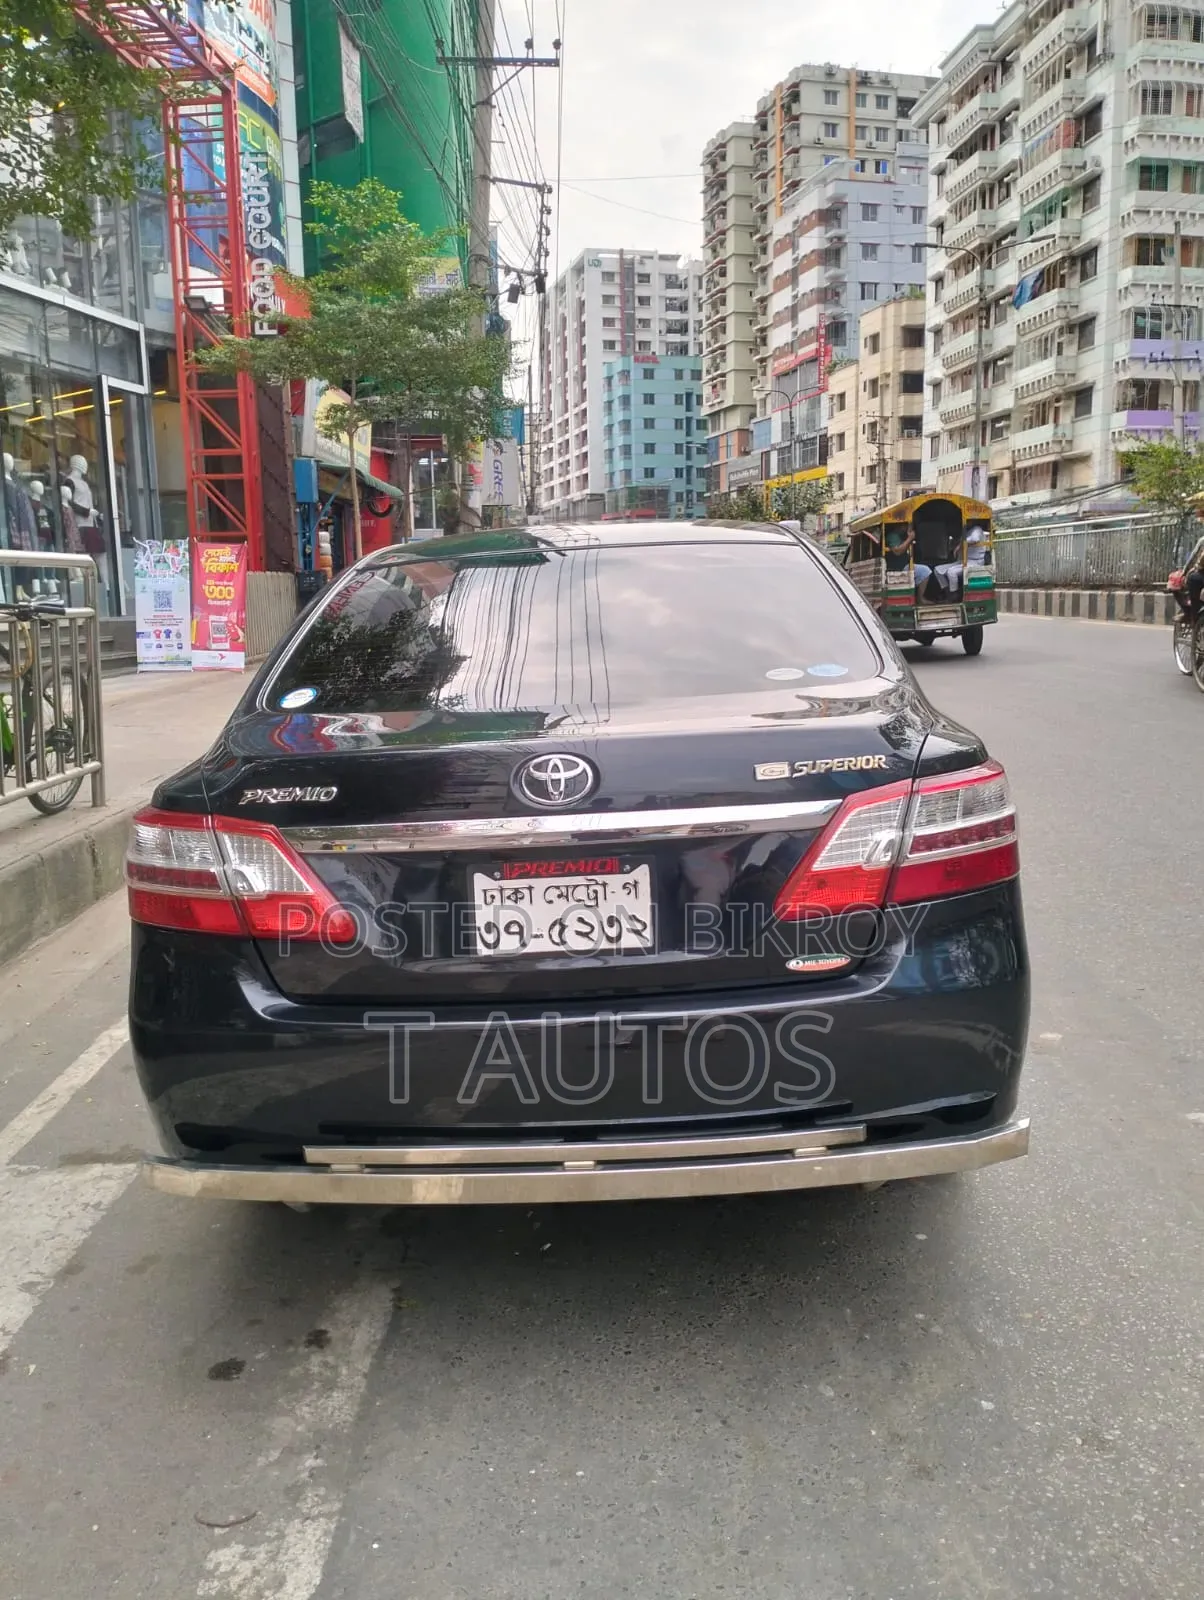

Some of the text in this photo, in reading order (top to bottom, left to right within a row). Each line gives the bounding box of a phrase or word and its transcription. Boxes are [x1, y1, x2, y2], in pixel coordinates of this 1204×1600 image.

[244, 151, 278, 335] FOOD COURT
[792, 754, 889, 778] SUPERIOR
[238, 786, 338, 805] PREMIO
[509, 857, 615, 878] PREMIO
[482, 884, 534, 906] ঢাকা
[477, 914, 651, 950] ৩৭-৫২৩২
